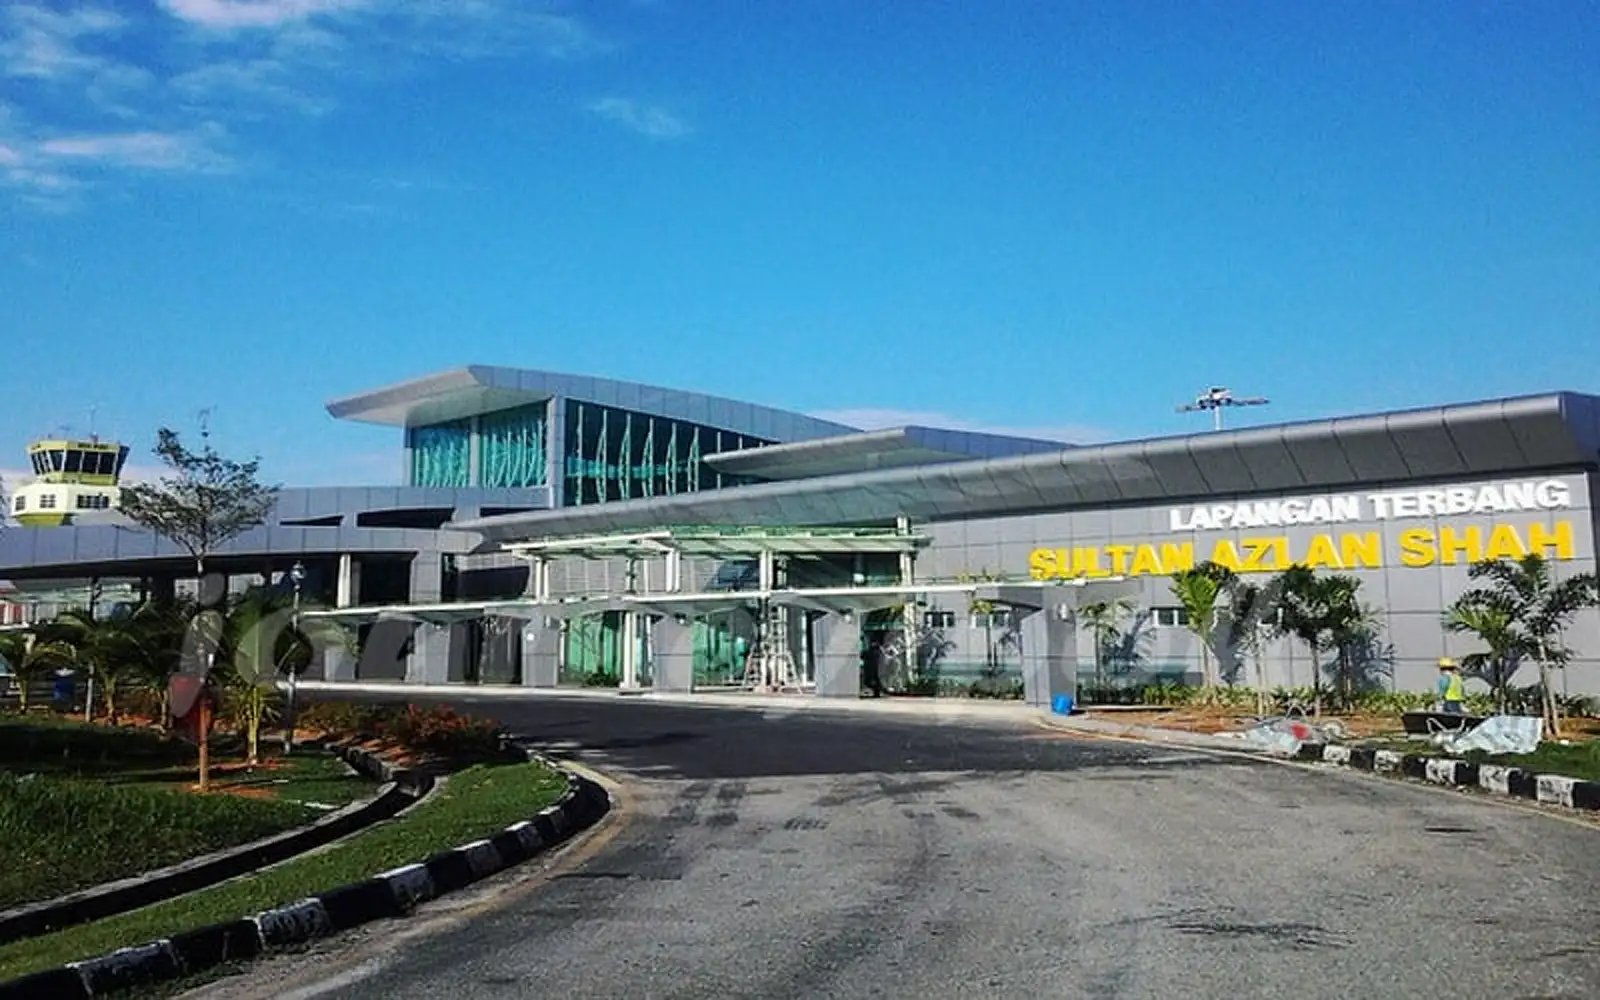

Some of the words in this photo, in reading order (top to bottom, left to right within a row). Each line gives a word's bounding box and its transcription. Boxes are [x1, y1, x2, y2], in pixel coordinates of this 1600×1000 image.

[1170, 495, 1359, 531] LAPANGAN
[1368, 480, 1571, 520] TERBANG
[1029, 541, 1195, 581] SULTAN
[1210, 532, 1383, 574] AZLAN
[1399, 520, 1574, 568] SHAH
